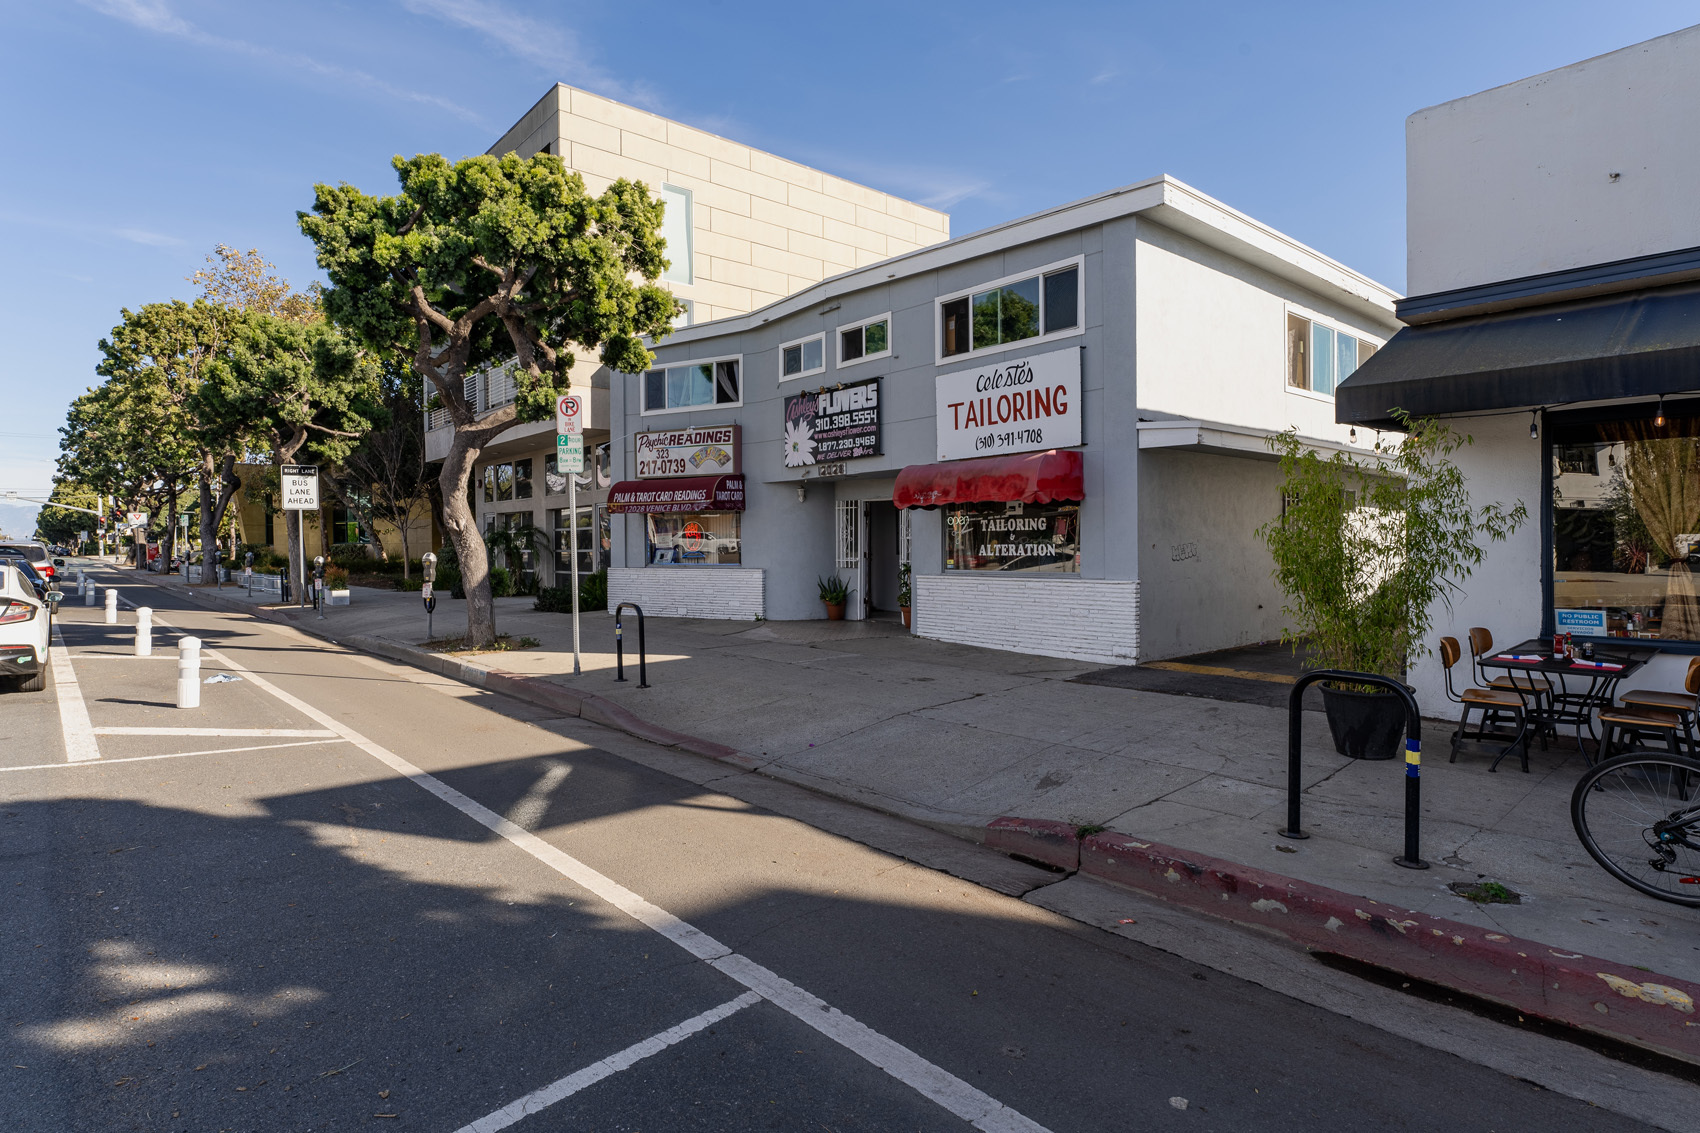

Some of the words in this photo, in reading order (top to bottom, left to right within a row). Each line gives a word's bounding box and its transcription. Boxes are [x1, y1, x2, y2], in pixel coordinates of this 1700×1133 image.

[819, 383, 877, 416] FLOWERS
[948, 385, 1068, 430] TAILORING
[816, 410, 876, 432] 310.398.5554
[560, 436, 566, 444] 2
[638, 433, 669, 453] Psychic
[669, 430, 732, 446] READINGS
[976, 432, 994, 450] (310)
[998, 428, 1042, 447] 391-4708
[656, 449, 669, 459] 323
[827, 449, 851, 459] DELIVER
[640, 458, 685, 474] 217-0739
[726, 480, 738, 489] PALM
[614, 492, 630, 502] PALM
[630, 492, 635, 502] &
[636, 492, 655, 502] TAROT
[656, 491, 673, 501] CARD
[674, 490, 707, 500] READINGS
[716, 491, 730, 500] TAROT
[731, 491, 743, 500] CARD
[980, 518, 1046, 532] TAILORING
[978, 543, 1056, 557] ALTERATION
